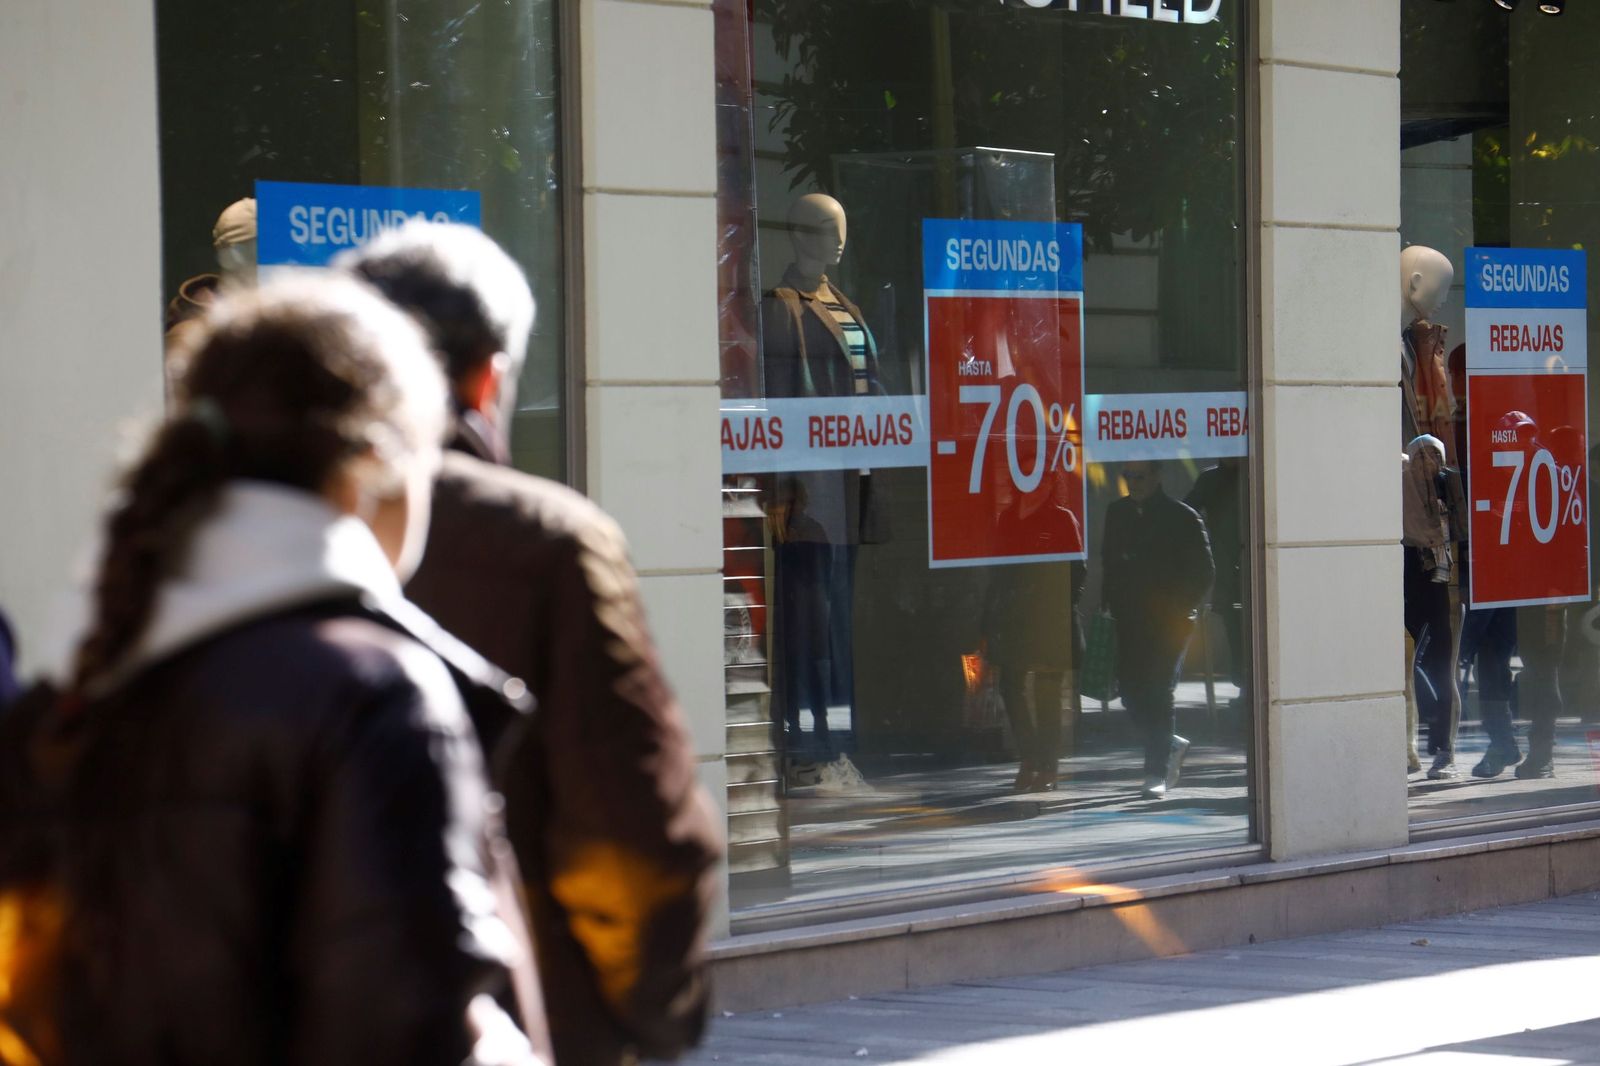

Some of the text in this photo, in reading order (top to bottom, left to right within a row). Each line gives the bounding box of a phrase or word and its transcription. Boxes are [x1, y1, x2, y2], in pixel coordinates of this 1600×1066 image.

[945, 238, 1061, 272] SEGUNDAS
[1482, 264, 1570, 292] SEGUNDAS
[1490, 324, 1563, 352] REBAJAS
[958, 360, 992, 376] HASTA
[808, 412, 912, 448] REBAJAS
[937, 383, 1076, 494] -70%
[1098, 408, 1187, 440] REBAJAS
[1491, 430, 1517, 443] HASTA
[1475, 448, 1582, 545] -70%
